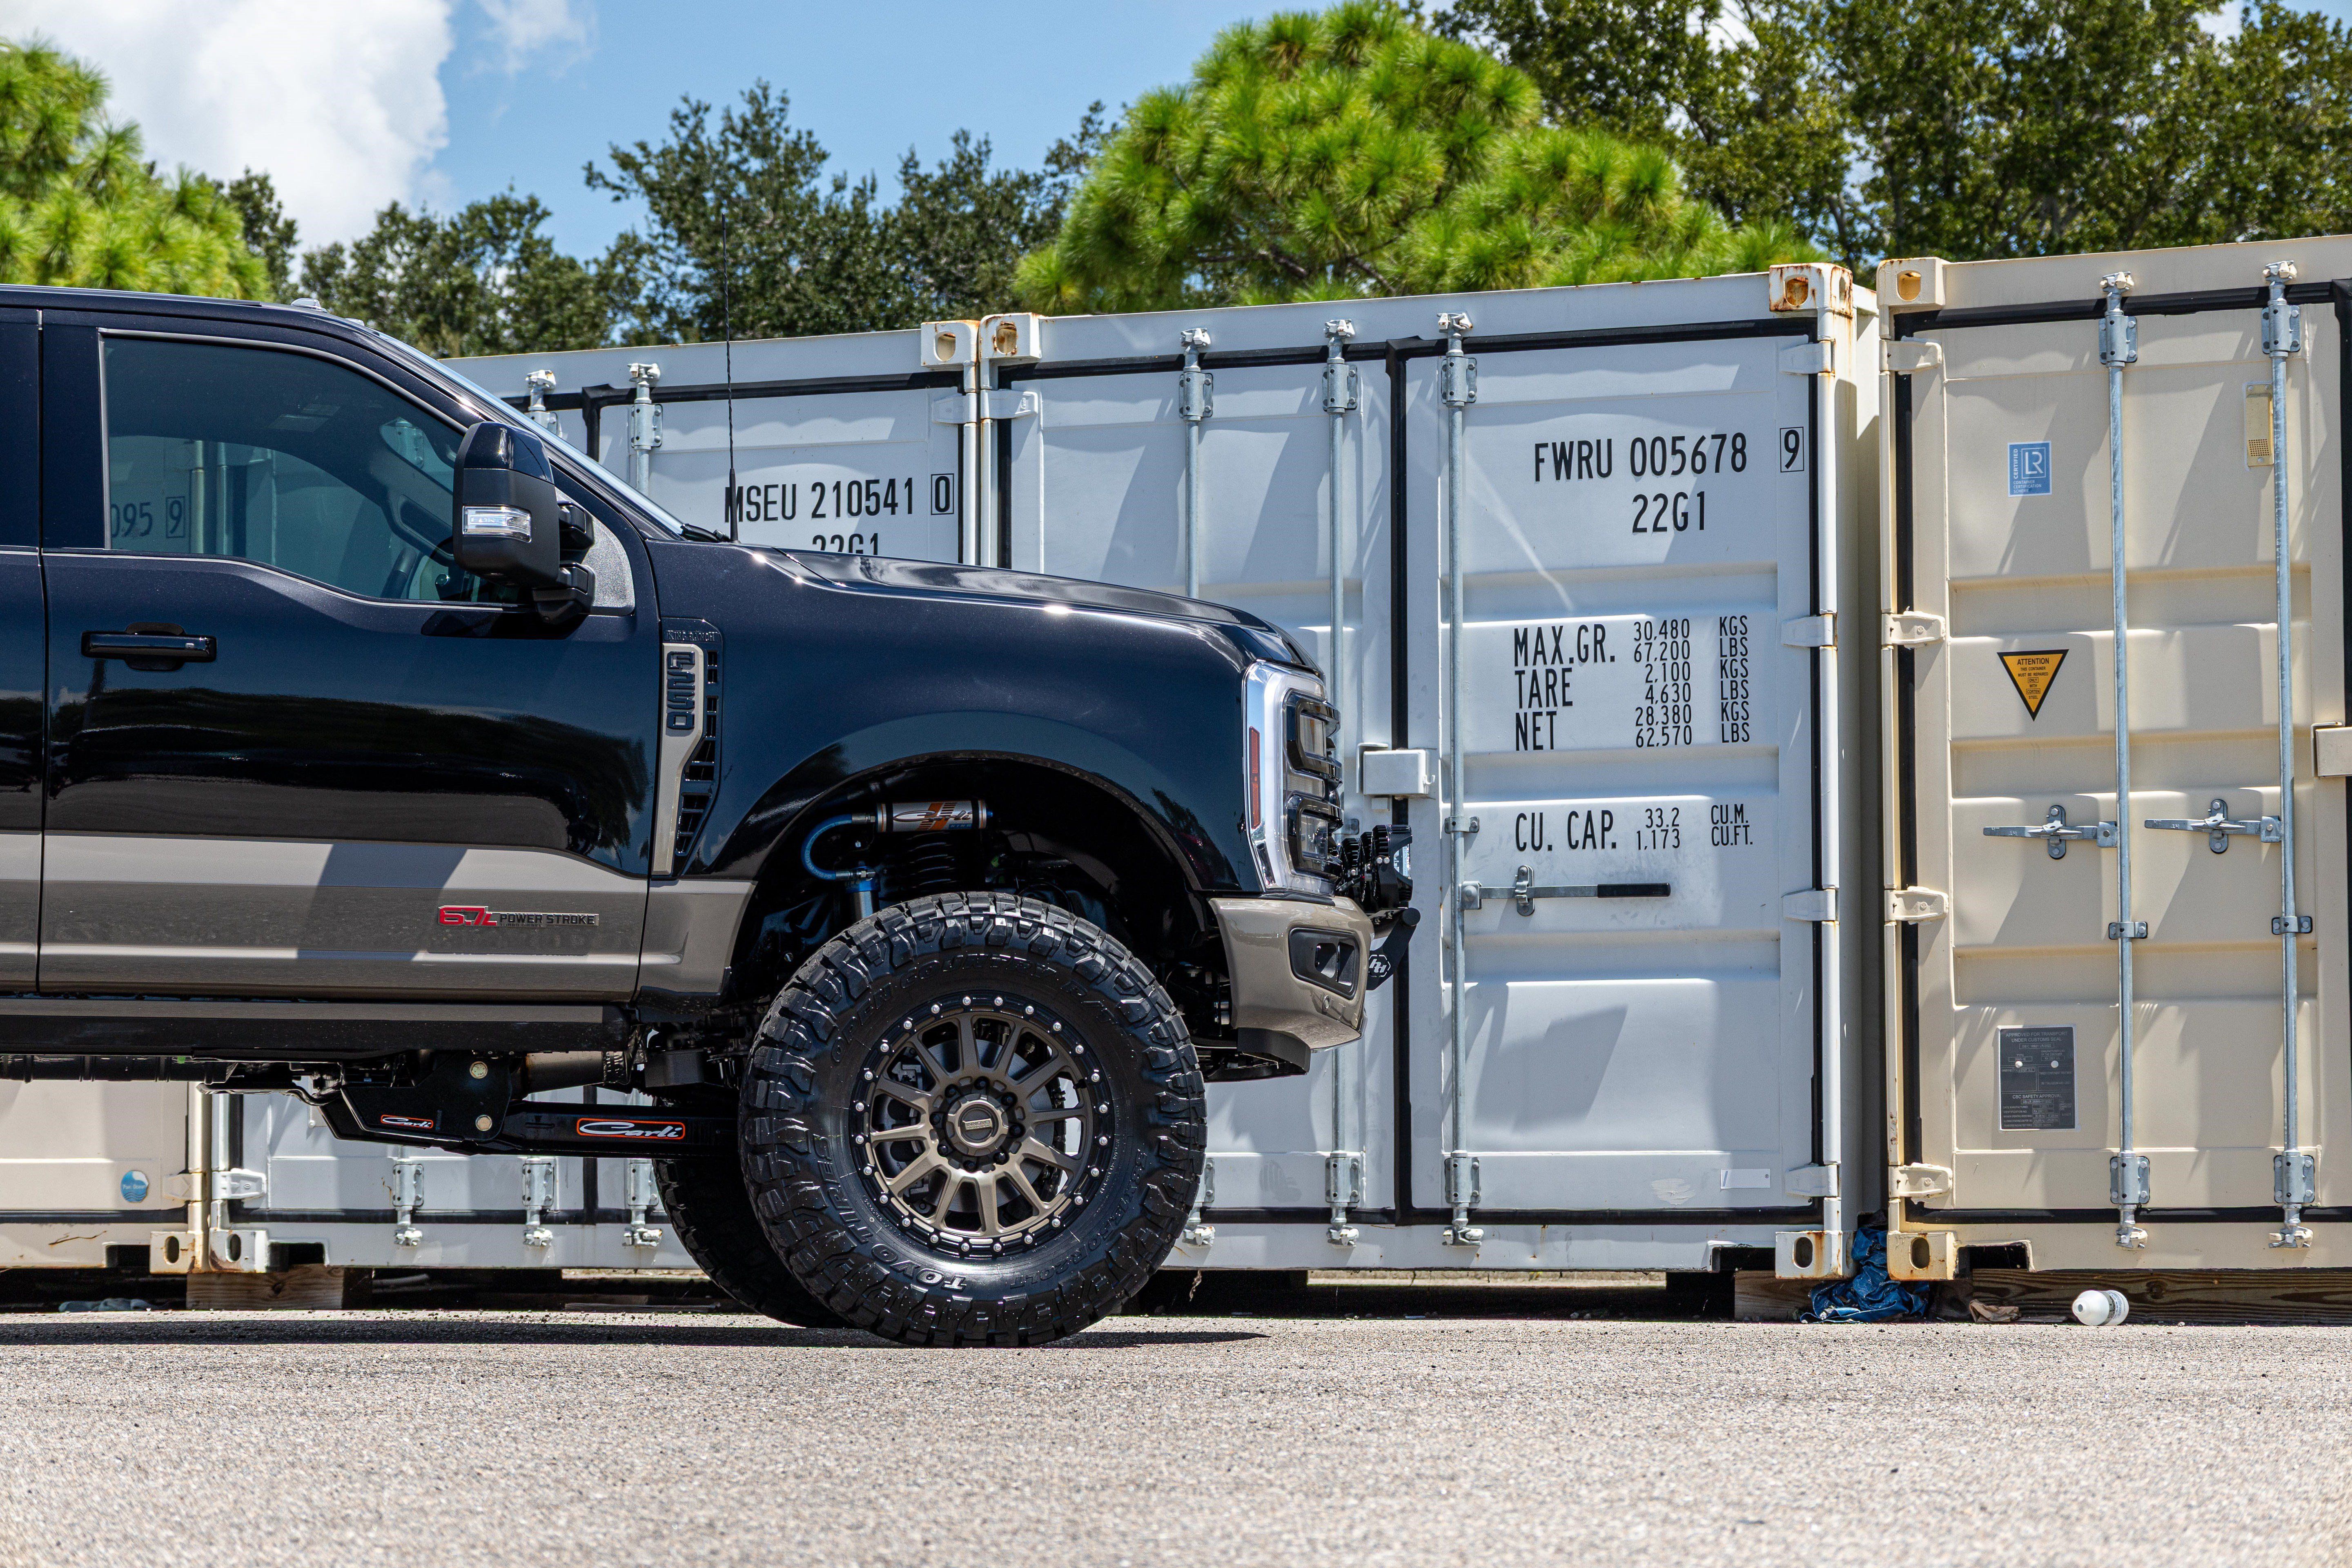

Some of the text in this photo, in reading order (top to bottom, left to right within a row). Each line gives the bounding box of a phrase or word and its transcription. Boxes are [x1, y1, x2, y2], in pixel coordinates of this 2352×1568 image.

[1534, 429, 1801, 483] FWRU 005678 9
[2025, 452, 2043, 474] LR
[724, 474, 951, 523] MSEU 210541 0
[1633, 491, 1705, 533] 22G1
[168, 499, 183, 534] 9
[688, 632, 715, 641] RANCH
[1633, 618, 1690, 641] 30,480
[1719, 615, 1748, 637] KGS
[1633, 637, 1748, 663] 67,200 LBS
[1515, 658, 1749, 709] TARE 2,100 KGS
[1645, 679, 1749, 705] 4,630 LBS
[1515, 701, 1750, 751] NET 28,380 KGS
[1636, 722, 1750, 748] 62,570 LBS
[1515, 804, 1749, 852] CU. CAP. 33.2 CU.M.
[1636, 824, 1753, 851] 1,173 CU.FT.
[439, 906, 595, 926] 6.7L POWER STROKE
[830, 981, 895, 1063] OPEN
[898, 953, 1057, 987] COUNTRY
[579, 1121, 680, 1138] Carli
[811, 1133, 873, 1244] TIRES
[871, 1241, 967, 1293] TOYO
